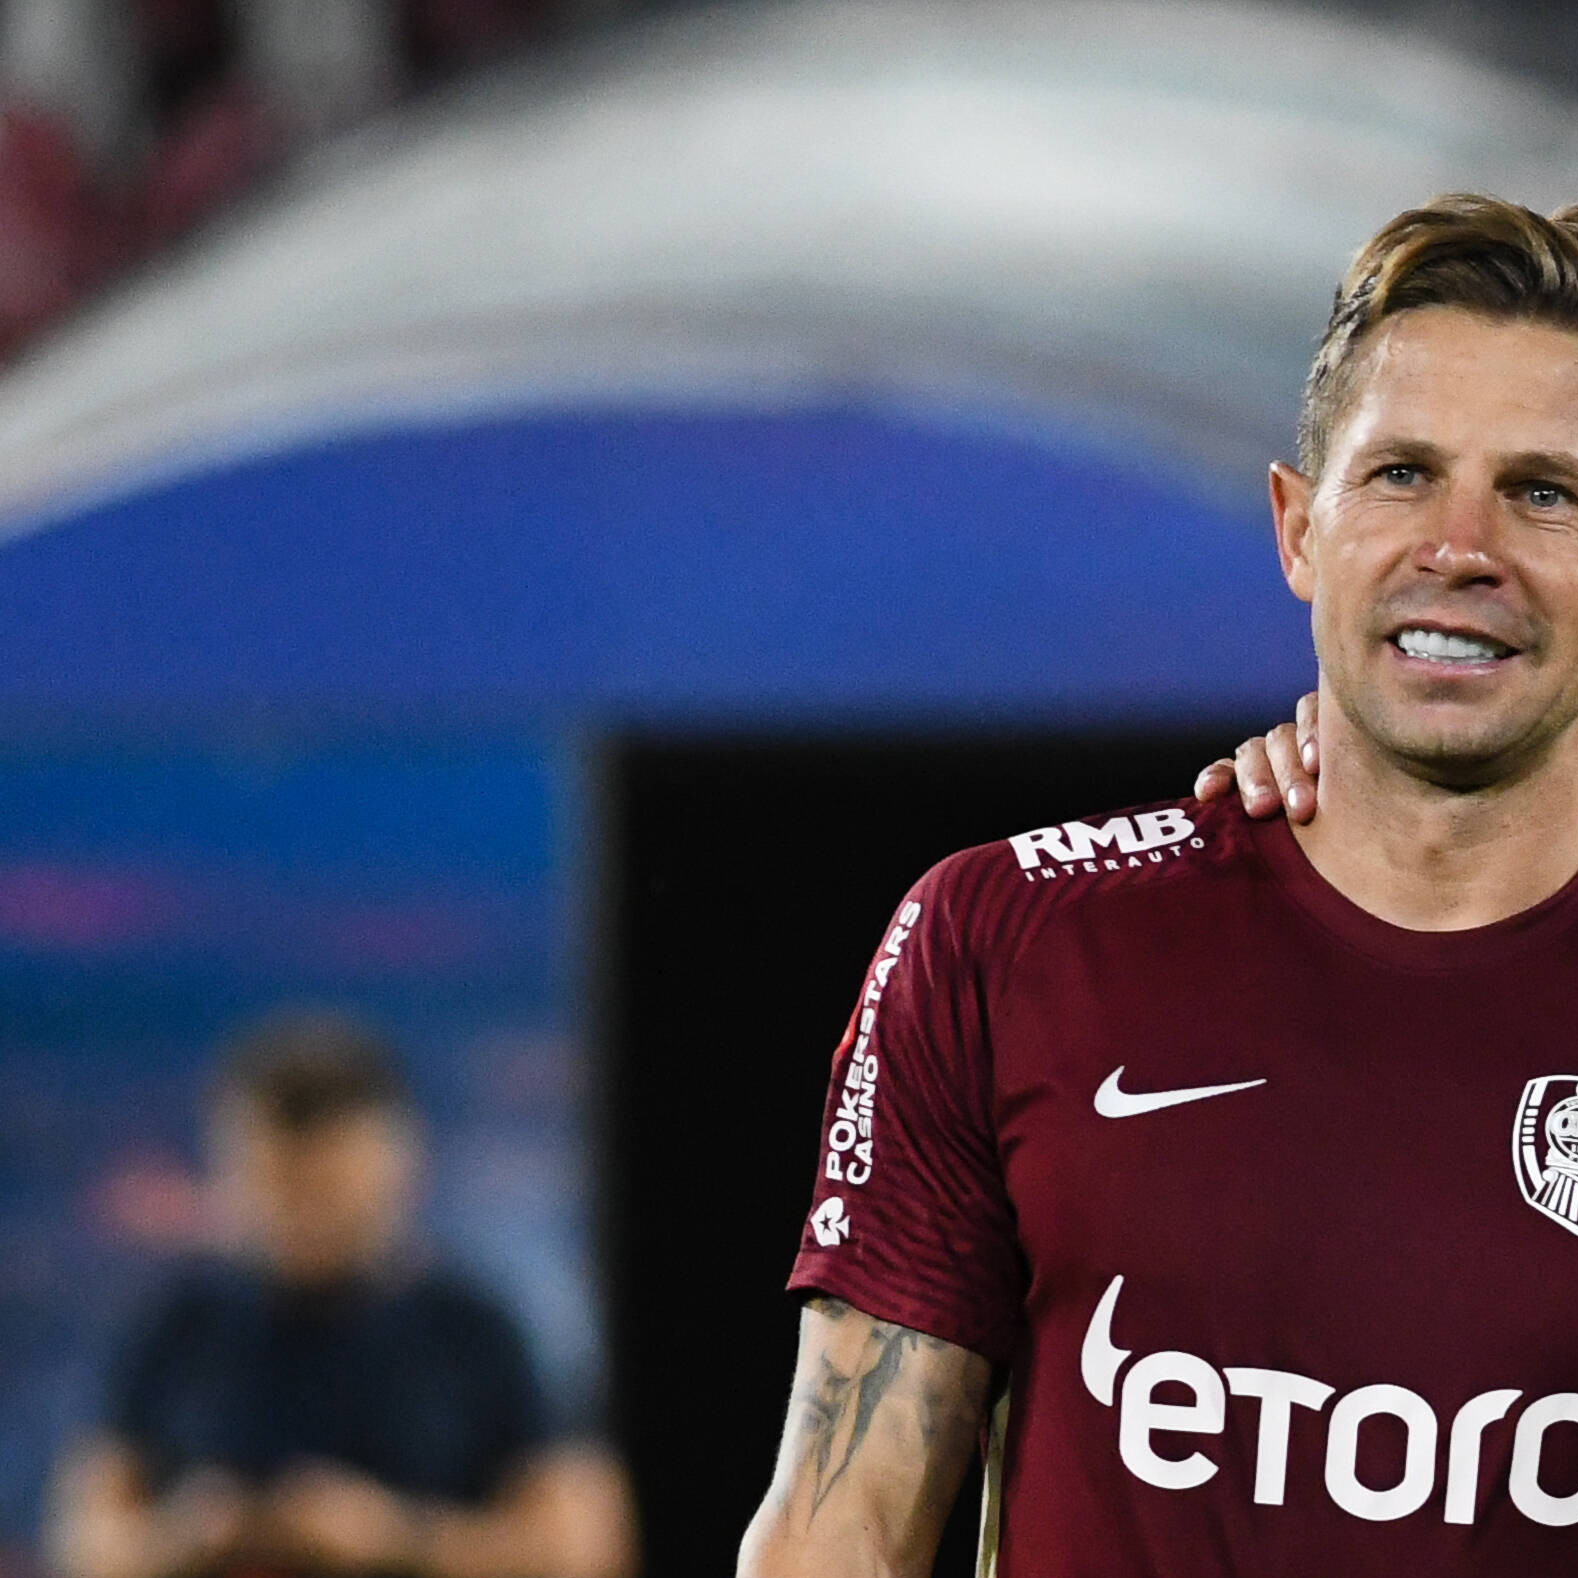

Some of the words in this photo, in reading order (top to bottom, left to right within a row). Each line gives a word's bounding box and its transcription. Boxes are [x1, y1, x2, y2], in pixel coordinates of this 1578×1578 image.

[1008, 808, 1195, 869] RMB
[1025, 837, 1204, 882] INTERAUTO
[826, 900, 922, 1181] POKERSTARS
[846, 1054, 878, 1186] CASINO
